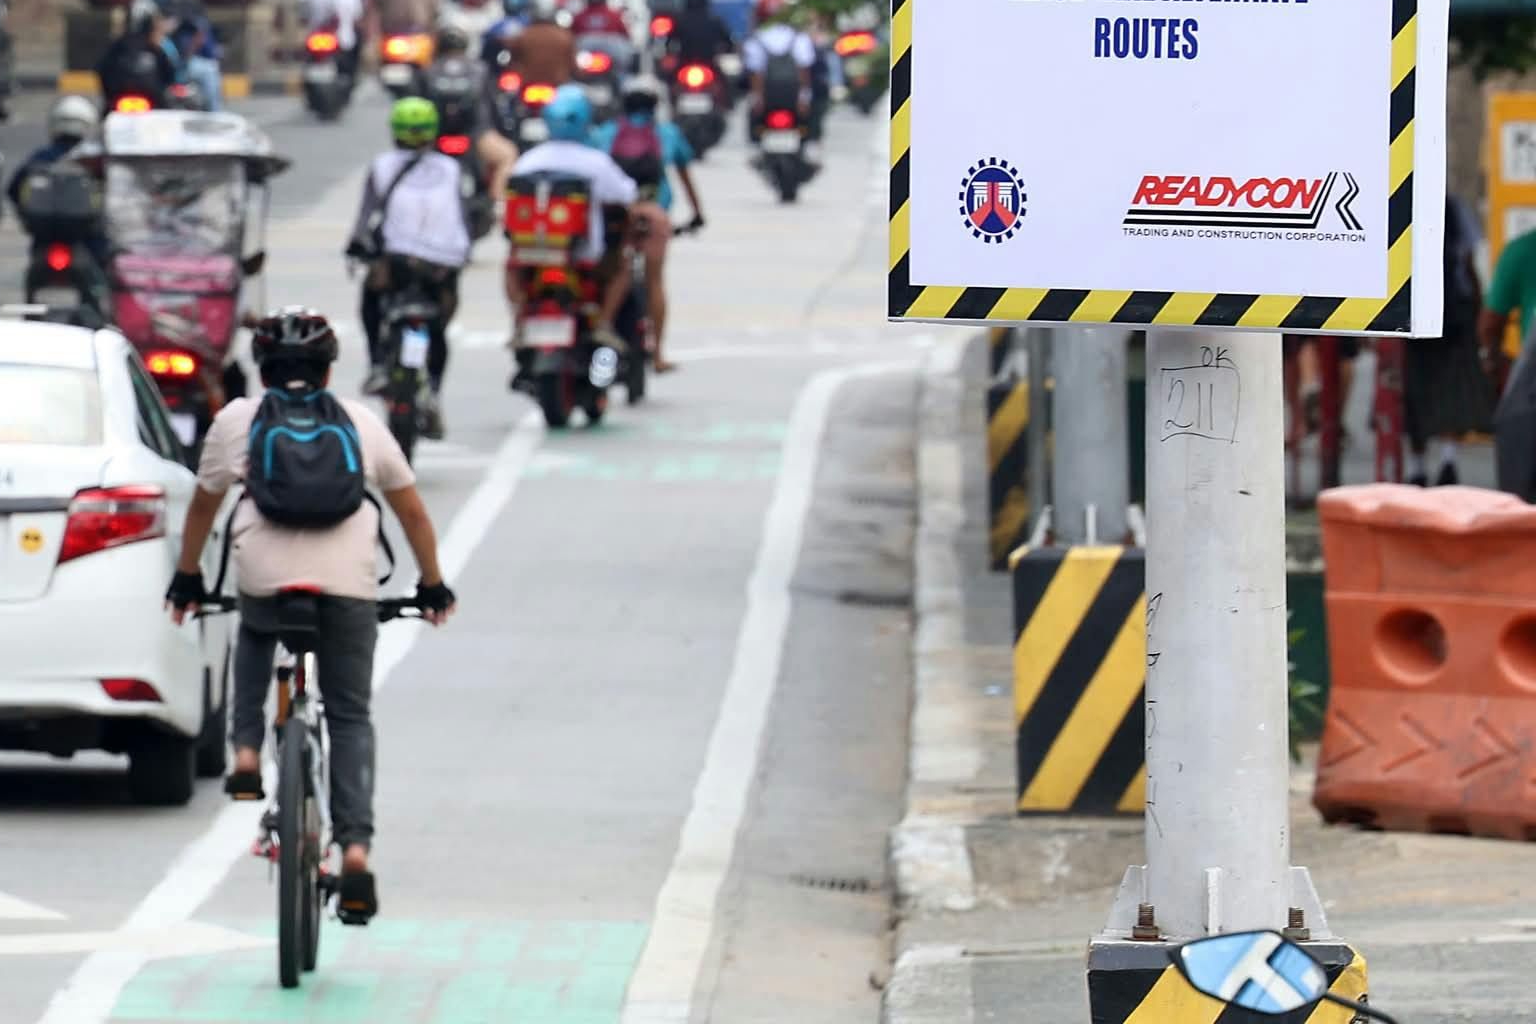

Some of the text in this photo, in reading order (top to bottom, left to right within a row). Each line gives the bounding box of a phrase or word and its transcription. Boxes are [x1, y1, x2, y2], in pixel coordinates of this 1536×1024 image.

[1094, 16, 1199, 60] ROUTES
[1131, 175, 1323, 209] READYCON
[1122, 227, 1366, 243] TRADING AND CONSTRUCTION CORPORATION
